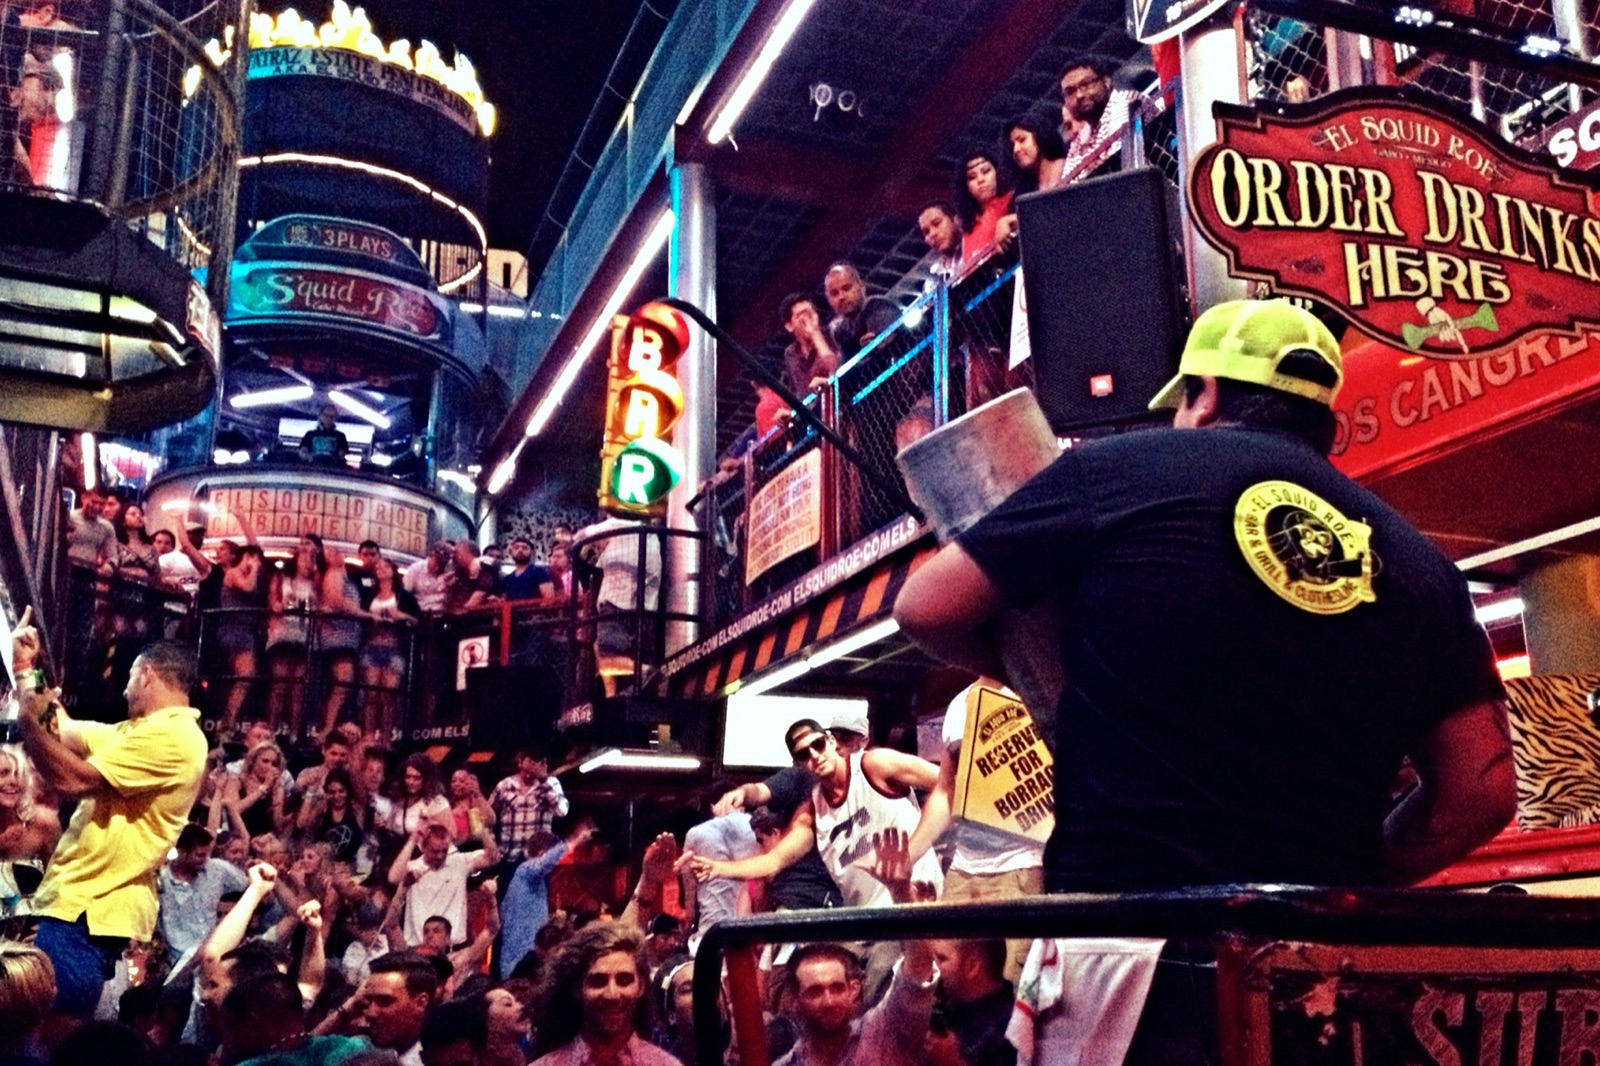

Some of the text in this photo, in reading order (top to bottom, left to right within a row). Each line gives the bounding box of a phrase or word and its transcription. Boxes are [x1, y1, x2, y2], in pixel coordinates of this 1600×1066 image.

[1324, 115, 1498, 181] EL SQUID ROE
[1210, 148, 1600, 283] ORDER DRINKS
[257, 274, 355, 307] Squid
[1344, 242, 1512, 307] HERE
[617, 326, 665, 505] BAR
[1251, 488, 1352, 541] EL SQUID ROE
[975, 722, 1036, 779] RESERV
[1009, 750, 1044, 783] FOR
